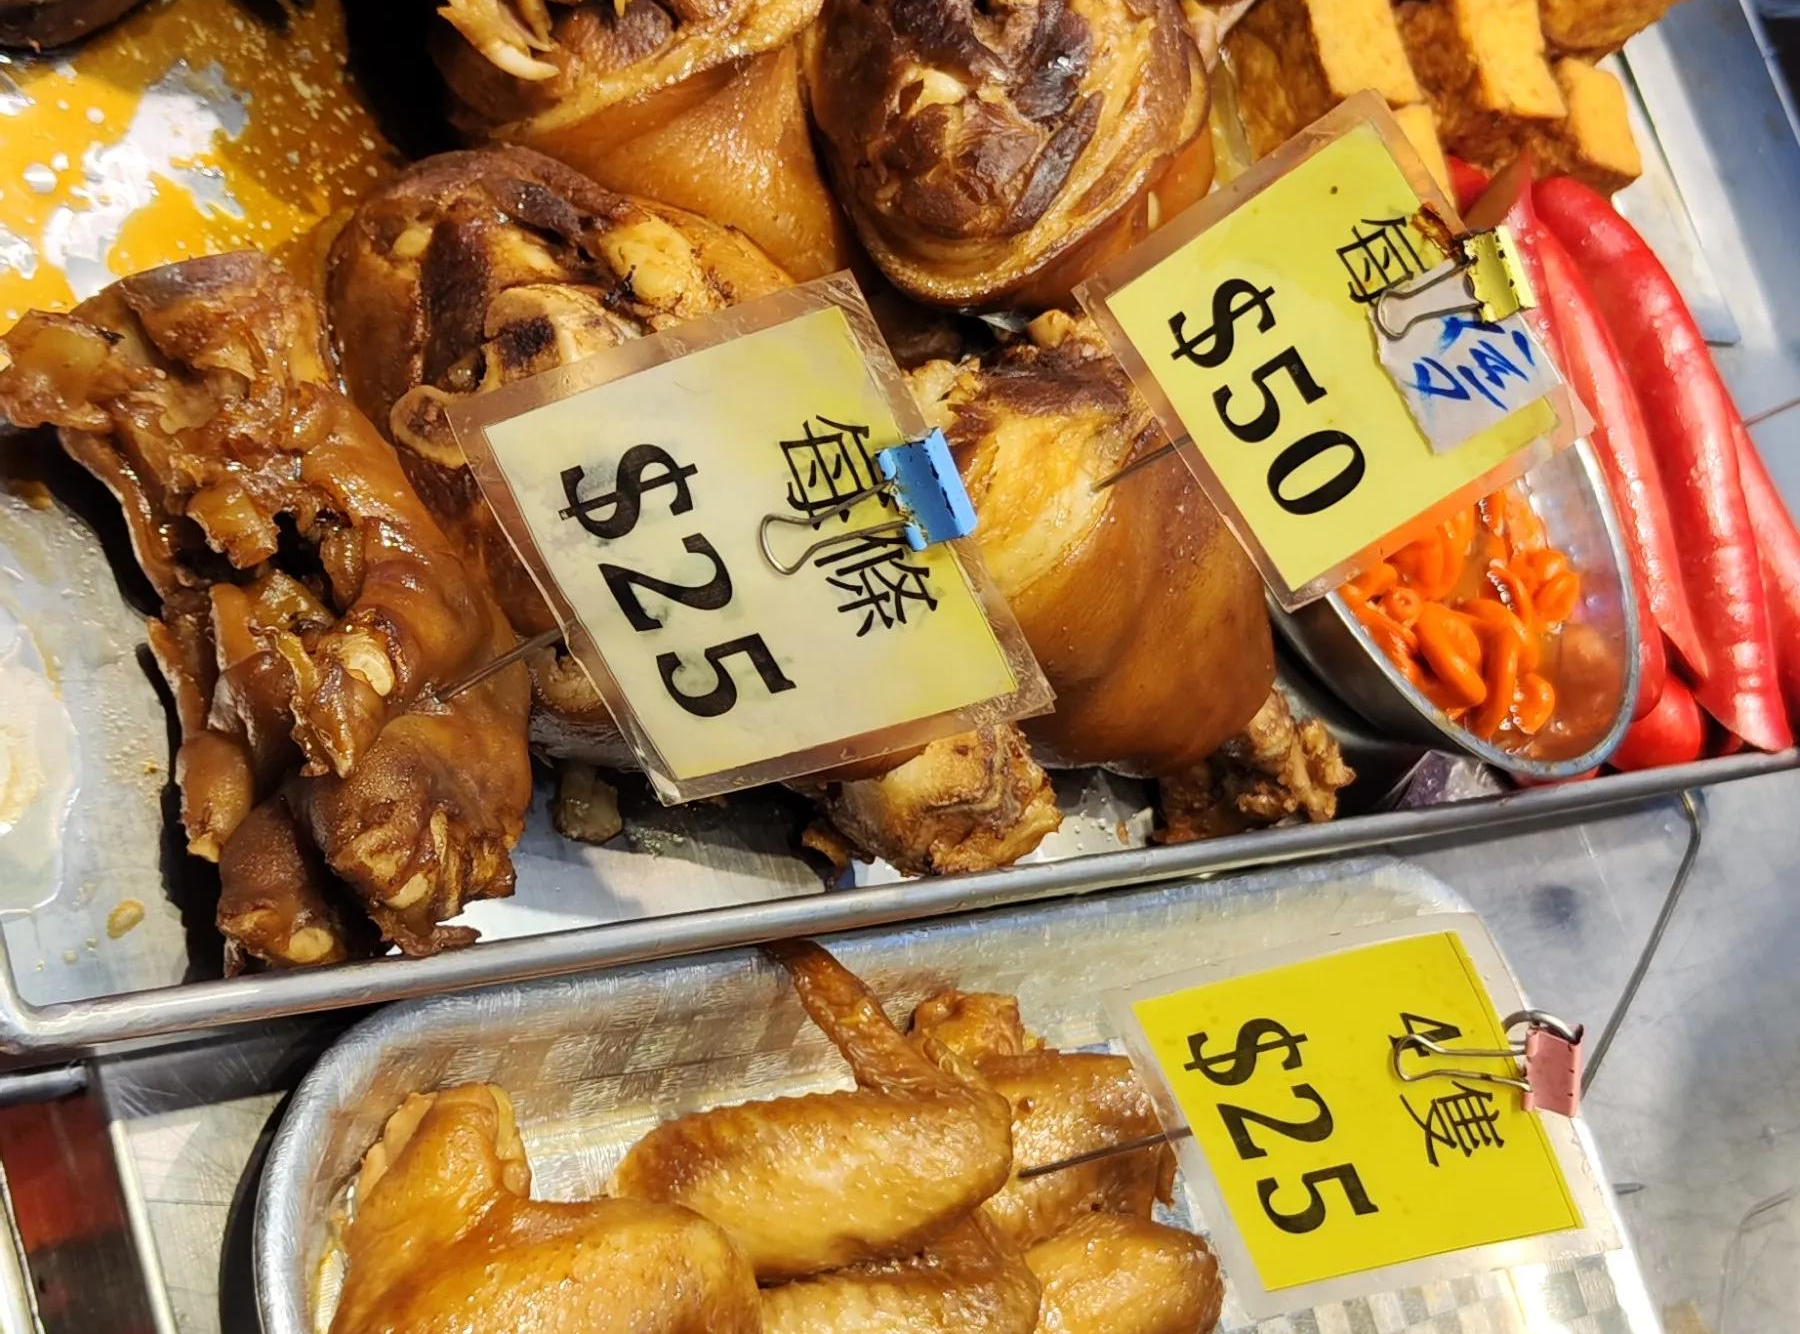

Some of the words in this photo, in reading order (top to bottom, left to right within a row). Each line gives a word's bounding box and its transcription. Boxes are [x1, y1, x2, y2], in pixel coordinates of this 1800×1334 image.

[1167, 278, 1366, 515] $50
[558, 443, 797, 718] $25
[780, 415, 939, 637] 每條
[1184, 1018, 1379, 1234] $25
[1388, 1012, 1505, 1167] 4隻
